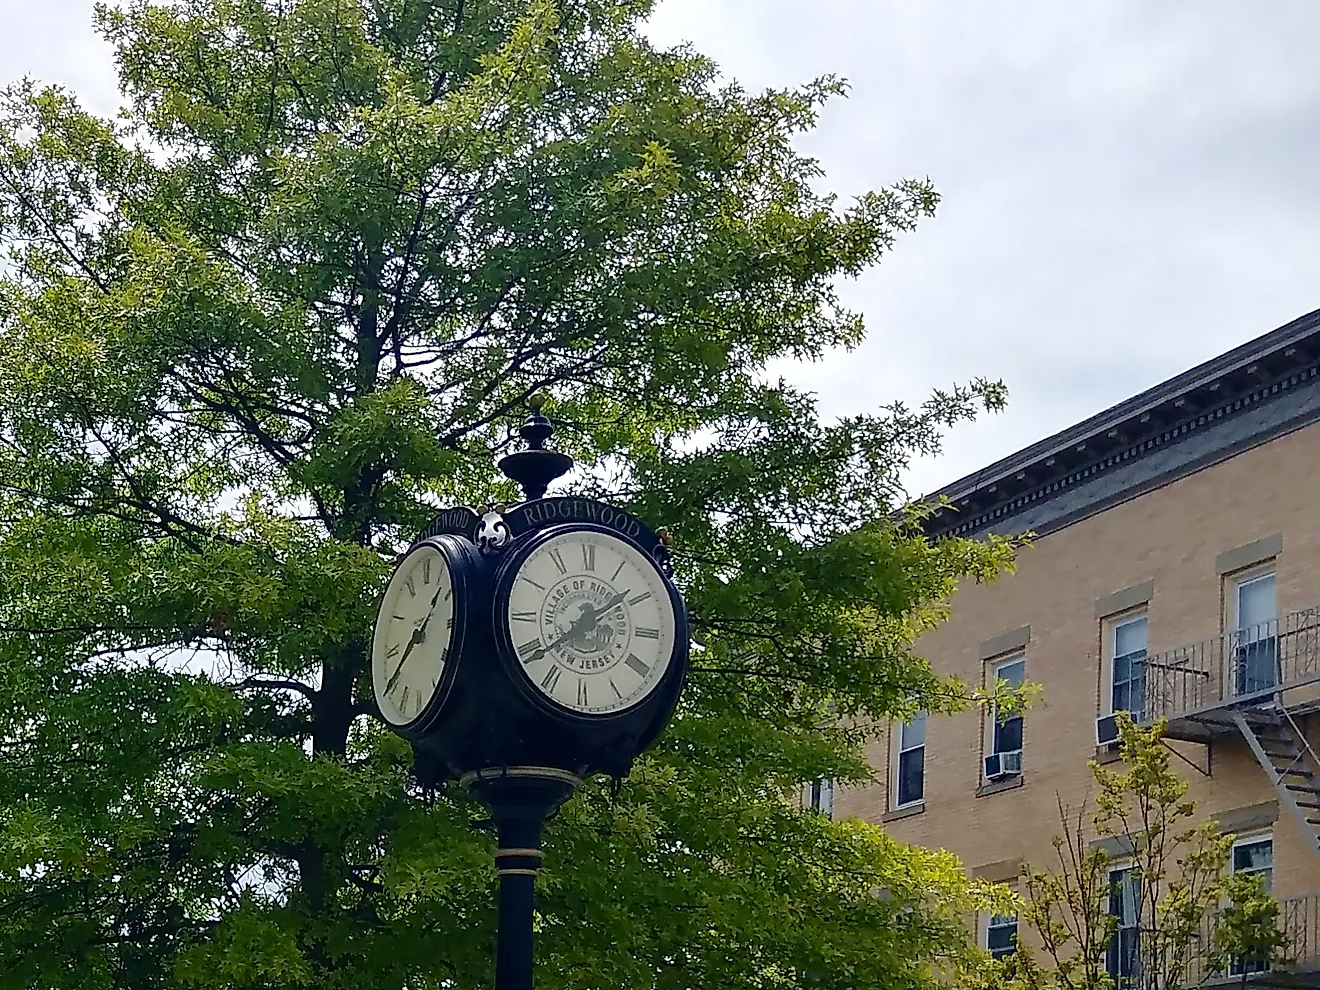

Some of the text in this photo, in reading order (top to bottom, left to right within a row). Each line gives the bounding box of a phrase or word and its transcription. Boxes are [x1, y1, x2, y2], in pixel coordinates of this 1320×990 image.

[523, 500, 641, 538] RIDGEWOOD
[545, 583, 571, 627] VILLAGE
[572, 579, 586, 591] OF
[579, 651, 616, 670] JERSEY
